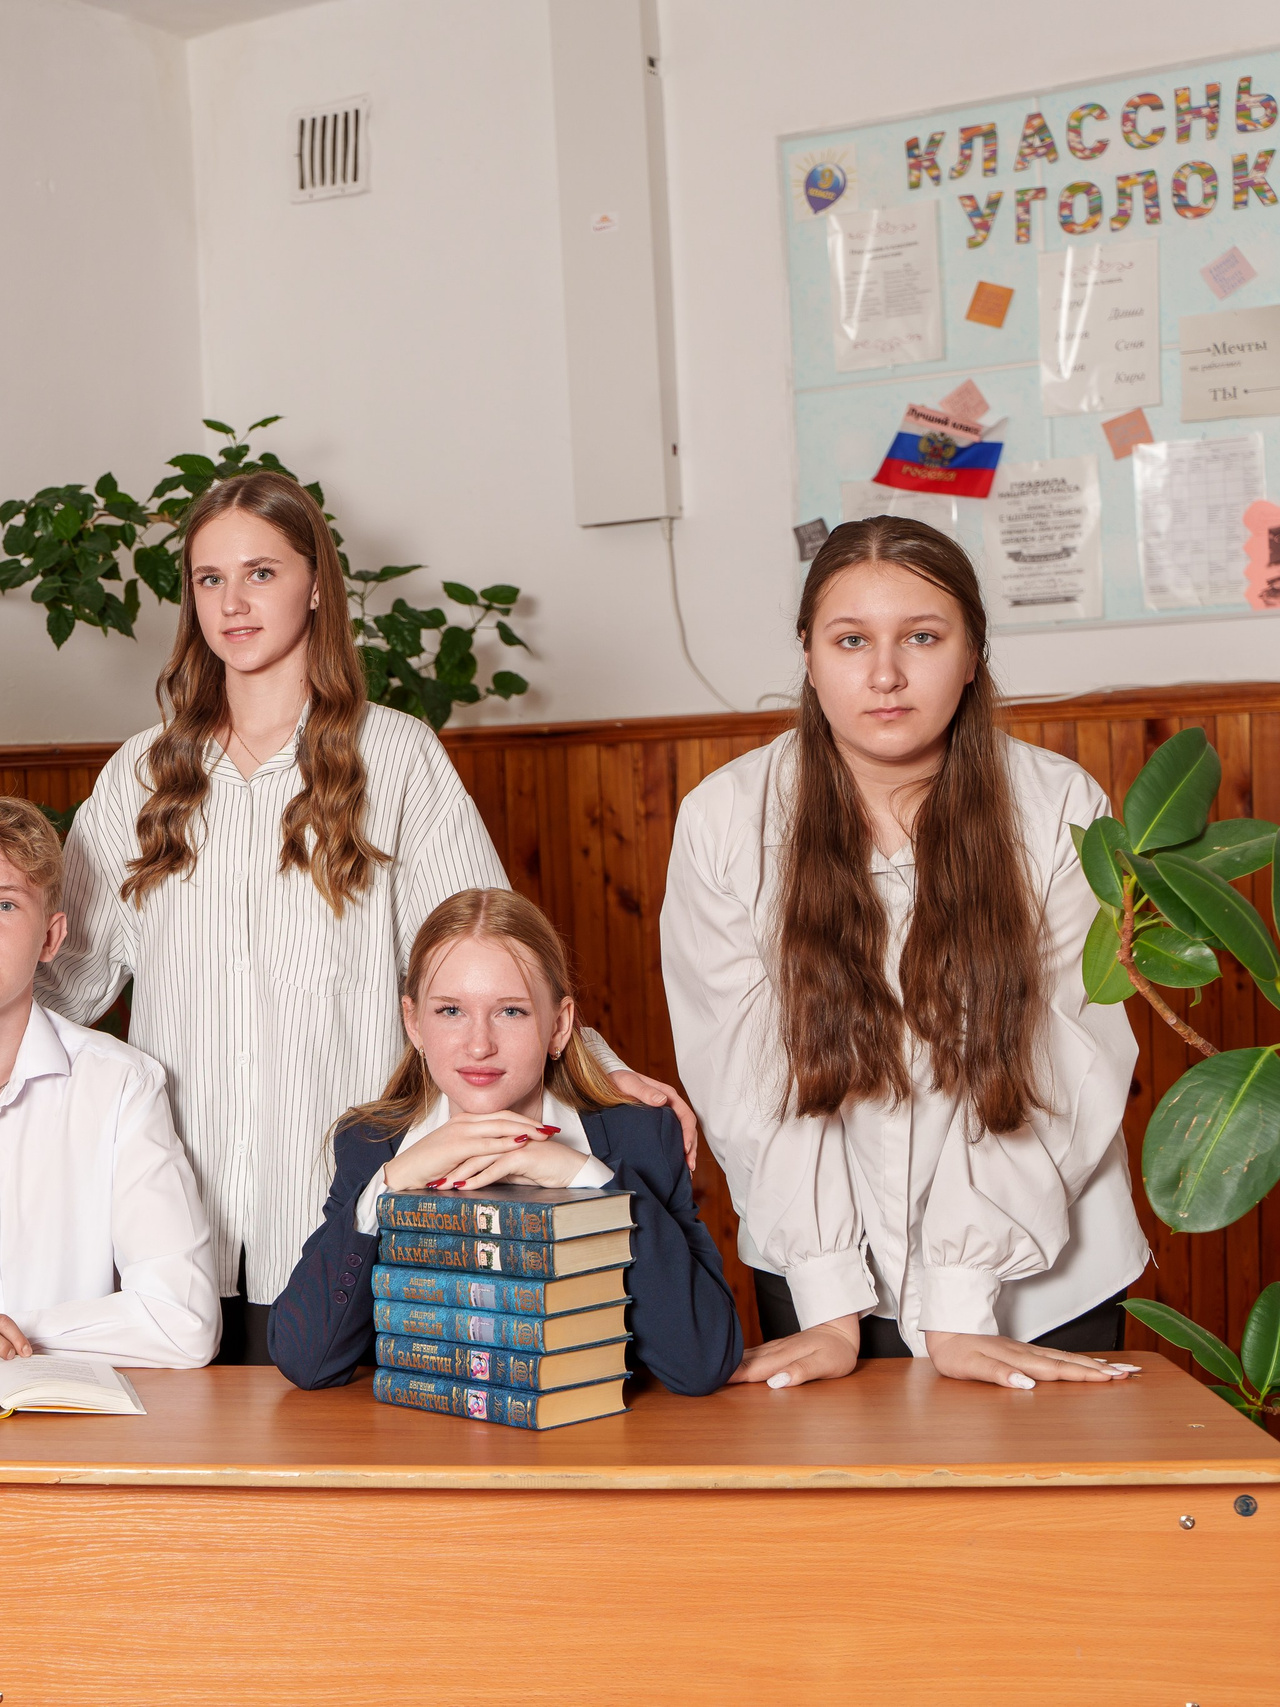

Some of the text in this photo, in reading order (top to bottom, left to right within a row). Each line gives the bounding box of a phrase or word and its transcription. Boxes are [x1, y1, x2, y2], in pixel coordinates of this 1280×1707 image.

[818, 168, 835, 189] 9
[958, 149, 1279, 249] УГОЛОК
[1211, 340, 1268, 357] Мечты
[907, 407, 950, 427] Лучший
[417, 1202, 437, 1212] АННА
[396, 1210, 462, 1231] АХМАТОВА
[418, 1237, 438, 1248] АННА
[397, 1246, 462, 1267] АХМАТОВА
[409, 1277, 436, 1288] АНДРЕЙ
[402, 1287, 445, 1303] БЕЛЫЙ
[409, 1310, 436, 1321] АНДРЕЙ
[402, 1320, 444, 1336] БЕЛЫЙ
[412, 1342, 439, 1354] ЕВГЕНИЙ
[397, 1350, 453, 1374] ЗАМЯТИН
[409, 1380, 436, 1393] ЕВГЕНИЙ
[394, 1387, 450, 1412] ЗАМЯТИН
